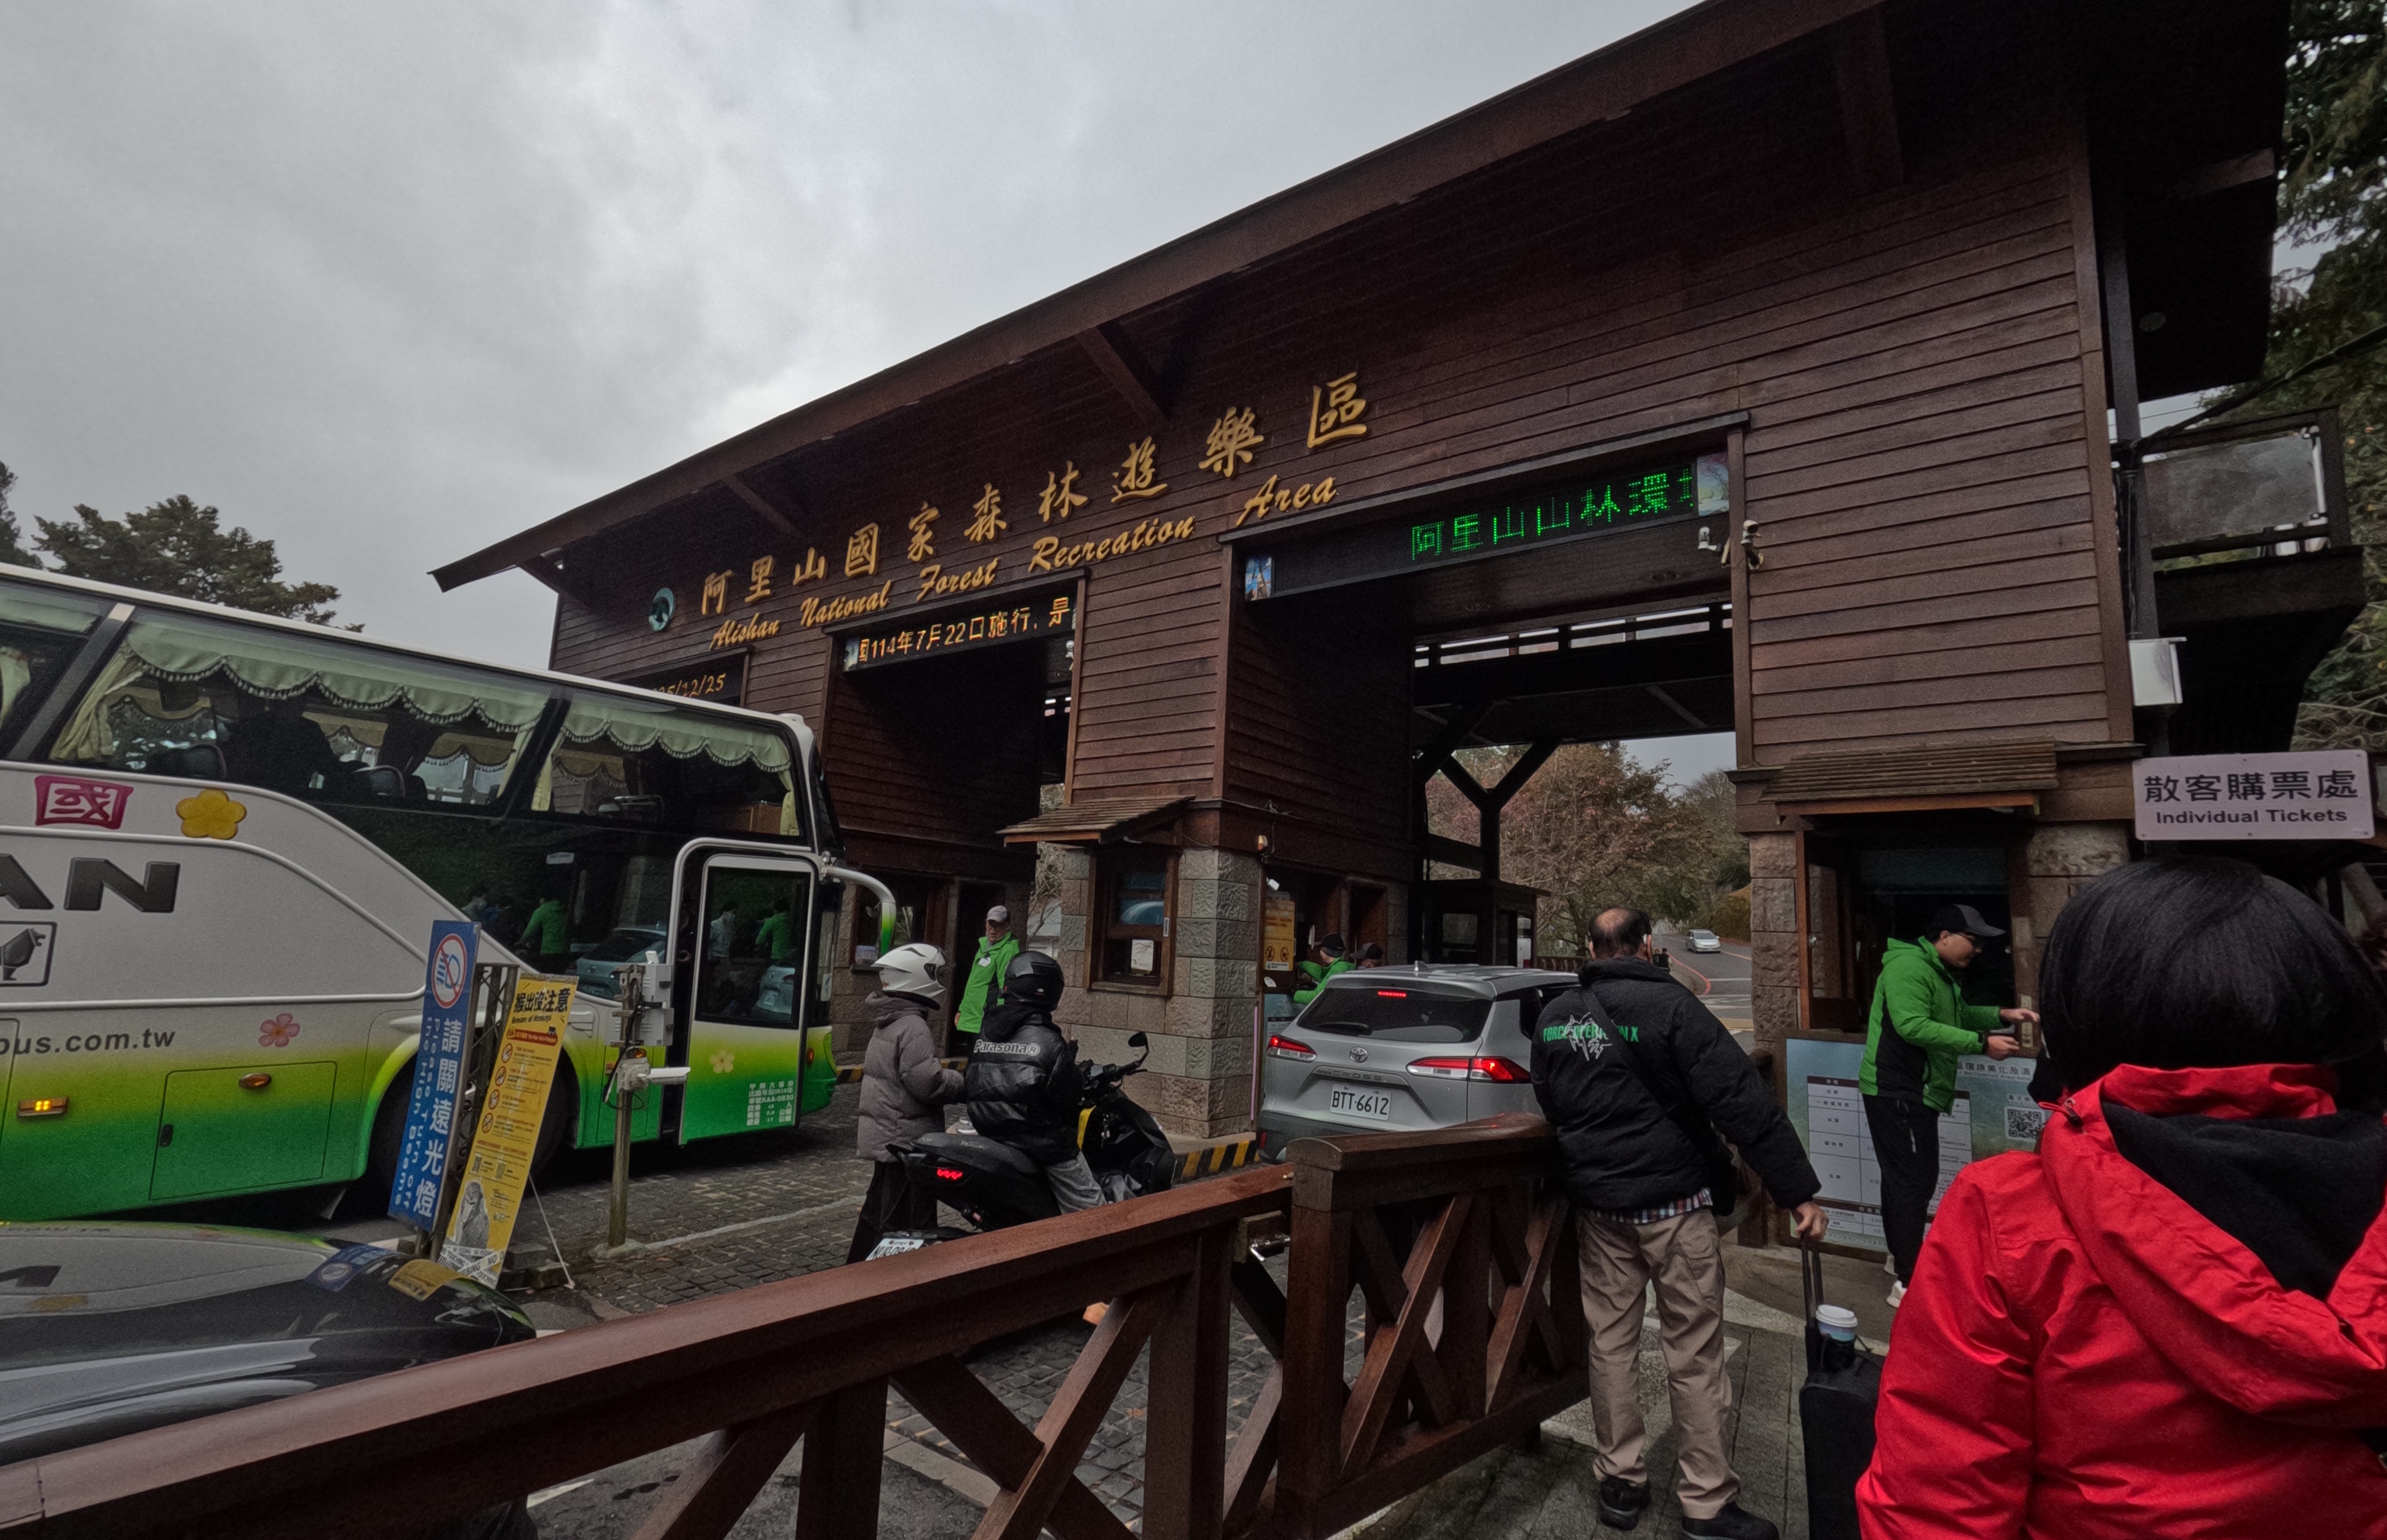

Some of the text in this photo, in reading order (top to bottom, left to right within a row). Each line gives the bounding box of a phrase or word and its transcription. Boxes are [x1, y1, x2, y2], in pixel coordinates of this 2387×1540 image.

[702, 371, 1367, 615] 阿里山國家森林遊樂區
[710, 474, 1338, 650] Alishan National Forest Recreation Area
[2144, 770, 2359, 803] 散客購票處
[2156, 809, 2348, 824] Individual Tickets
[513, 987, 570, 1013] 猴出沒注意
[1333, 1070, 1383, 1081] CROSS
[413, 1018, 462, 1218] 請關遠光燈
